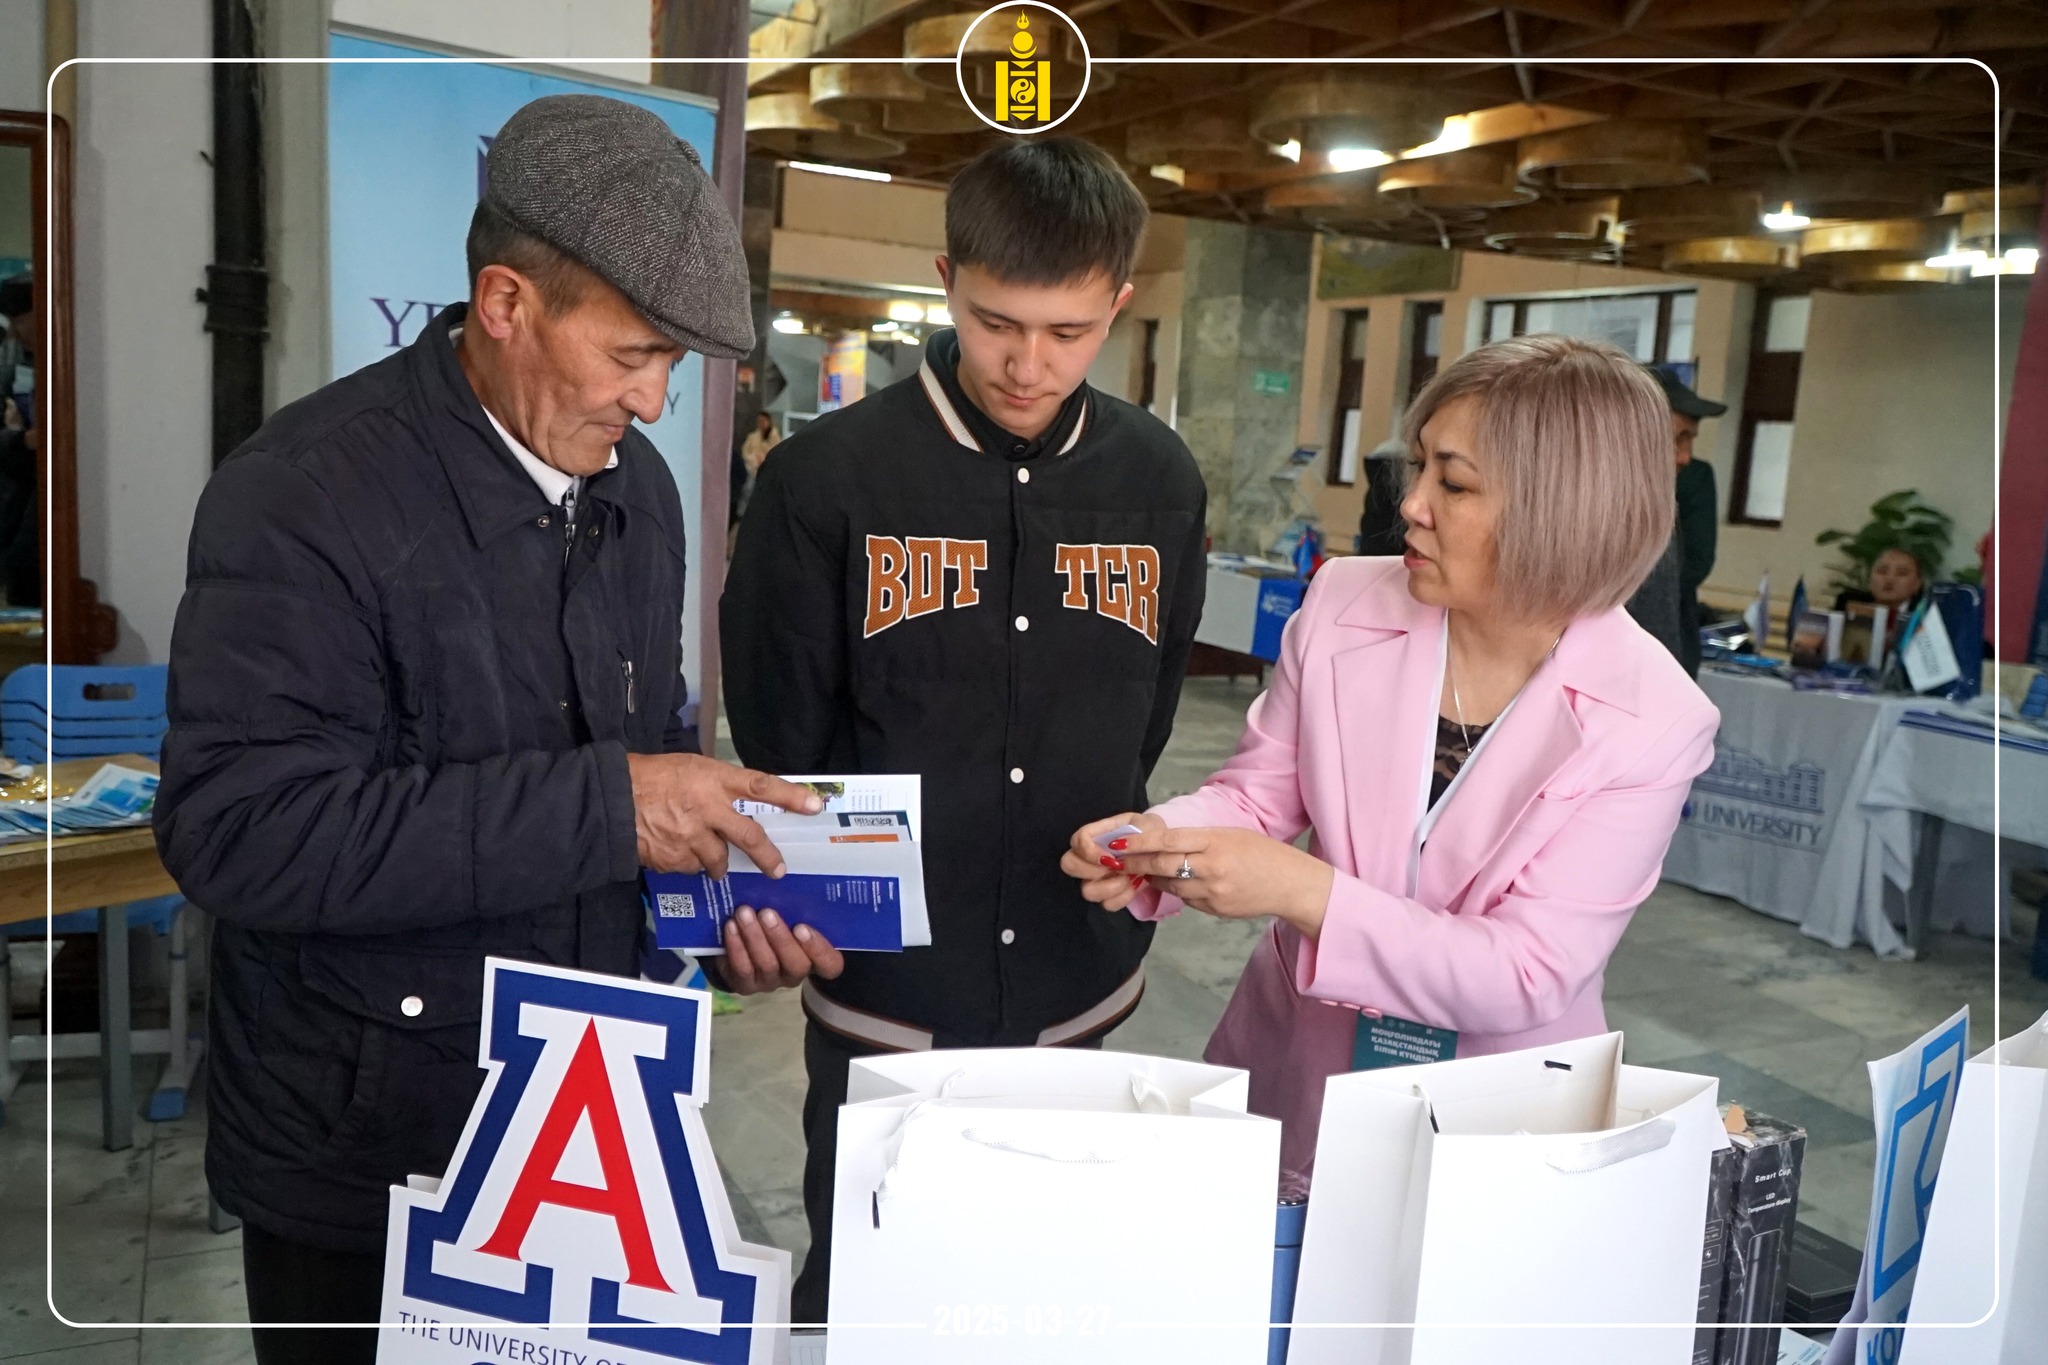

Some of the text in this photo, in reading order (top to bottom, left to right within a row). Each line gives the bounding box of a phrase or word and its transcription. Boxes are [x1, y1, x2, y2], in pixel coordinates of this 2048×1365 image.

[1703, 802, 1822, 846] UNIVERSITY
[1754, 1168, 1792, 1183] Smart Cup
[398, 1311, 441, 1341] THE
